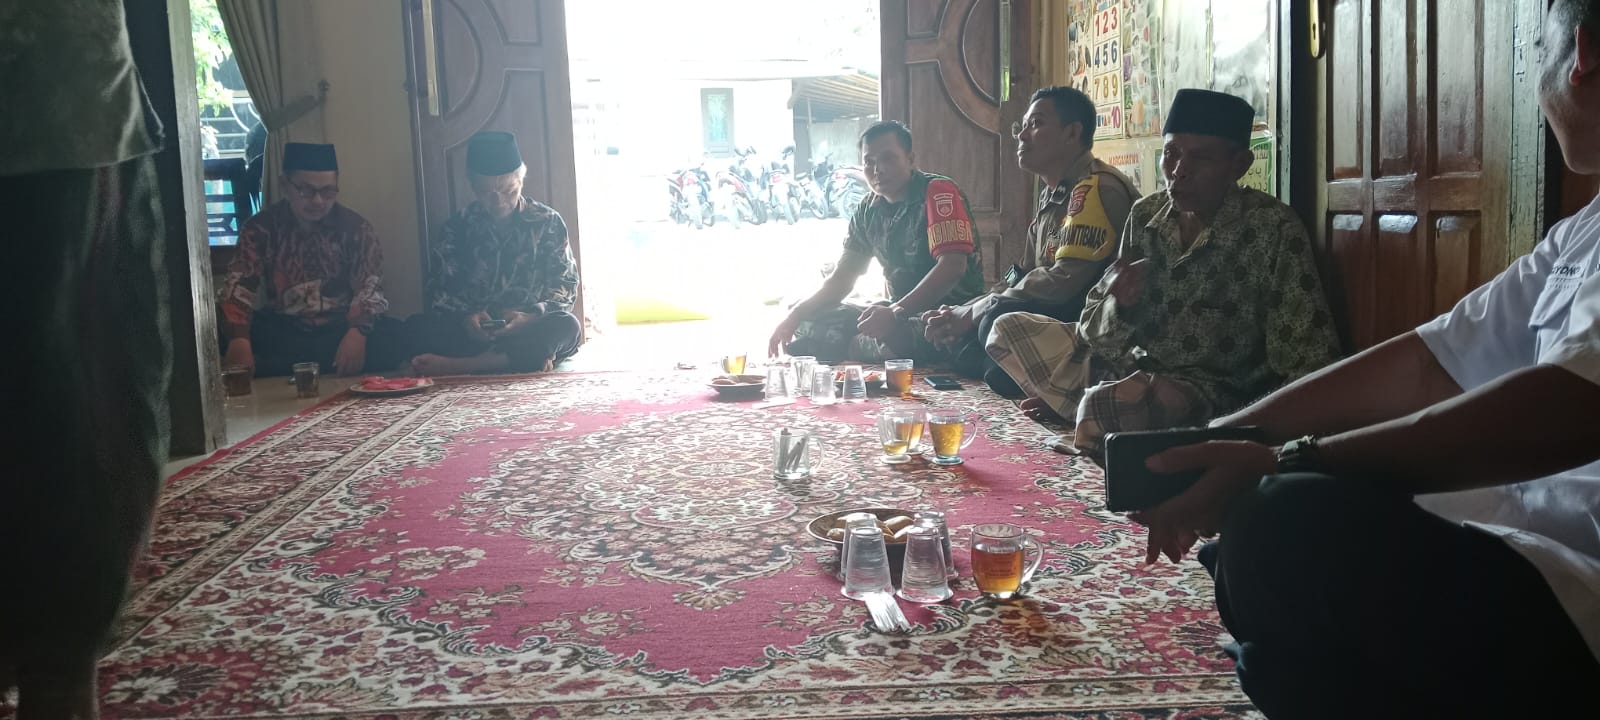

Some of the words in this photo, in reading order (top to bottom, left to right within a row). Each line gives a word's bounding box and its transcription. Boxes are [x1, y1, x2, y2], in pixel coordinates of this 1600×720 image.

[1095, 15, 1100, 36] 1
[1103, 11, 1109, 34] 2
[1111, 6, 1117, 30] 3
[1094, 46, 1100, 68] 4
[1103, 43, 1109, 66] 5
[1111, 40, 1117, 63] 6
[1094, 77, 1100, 99] 7
[1103, 75, 1109, 98] 8
[1111, 73, 1118, 97] 9
[1111, 106, 1120, 128] 10
